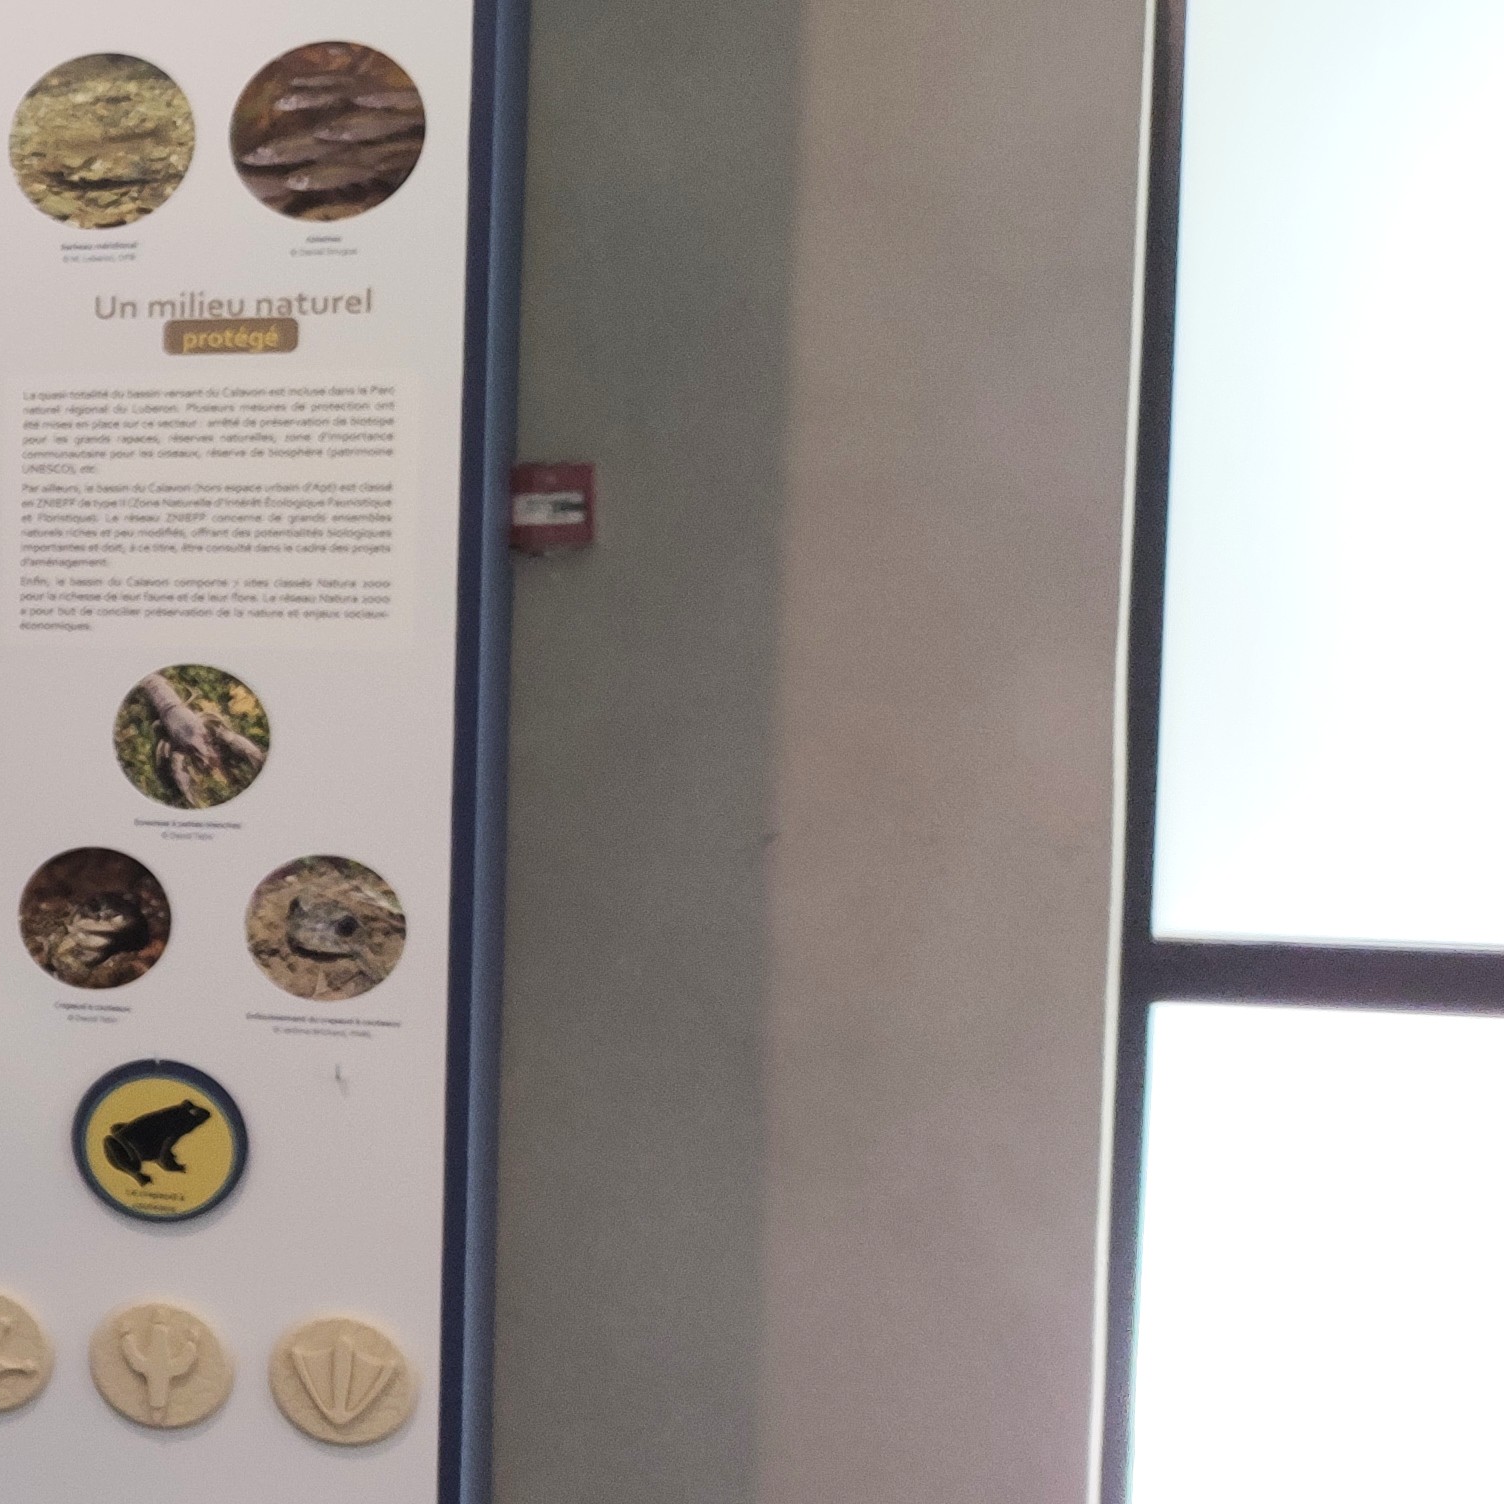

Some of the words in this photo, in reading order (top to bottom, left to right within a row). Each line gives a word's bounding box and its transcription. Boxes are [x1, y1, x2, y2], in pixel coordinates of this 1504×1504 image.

[95, 295, 137, 318] Un
[148, 292, 245, 316] milieu
[255, 288, 371, 314] naturel
[176, 324, 279, 355] protégé
